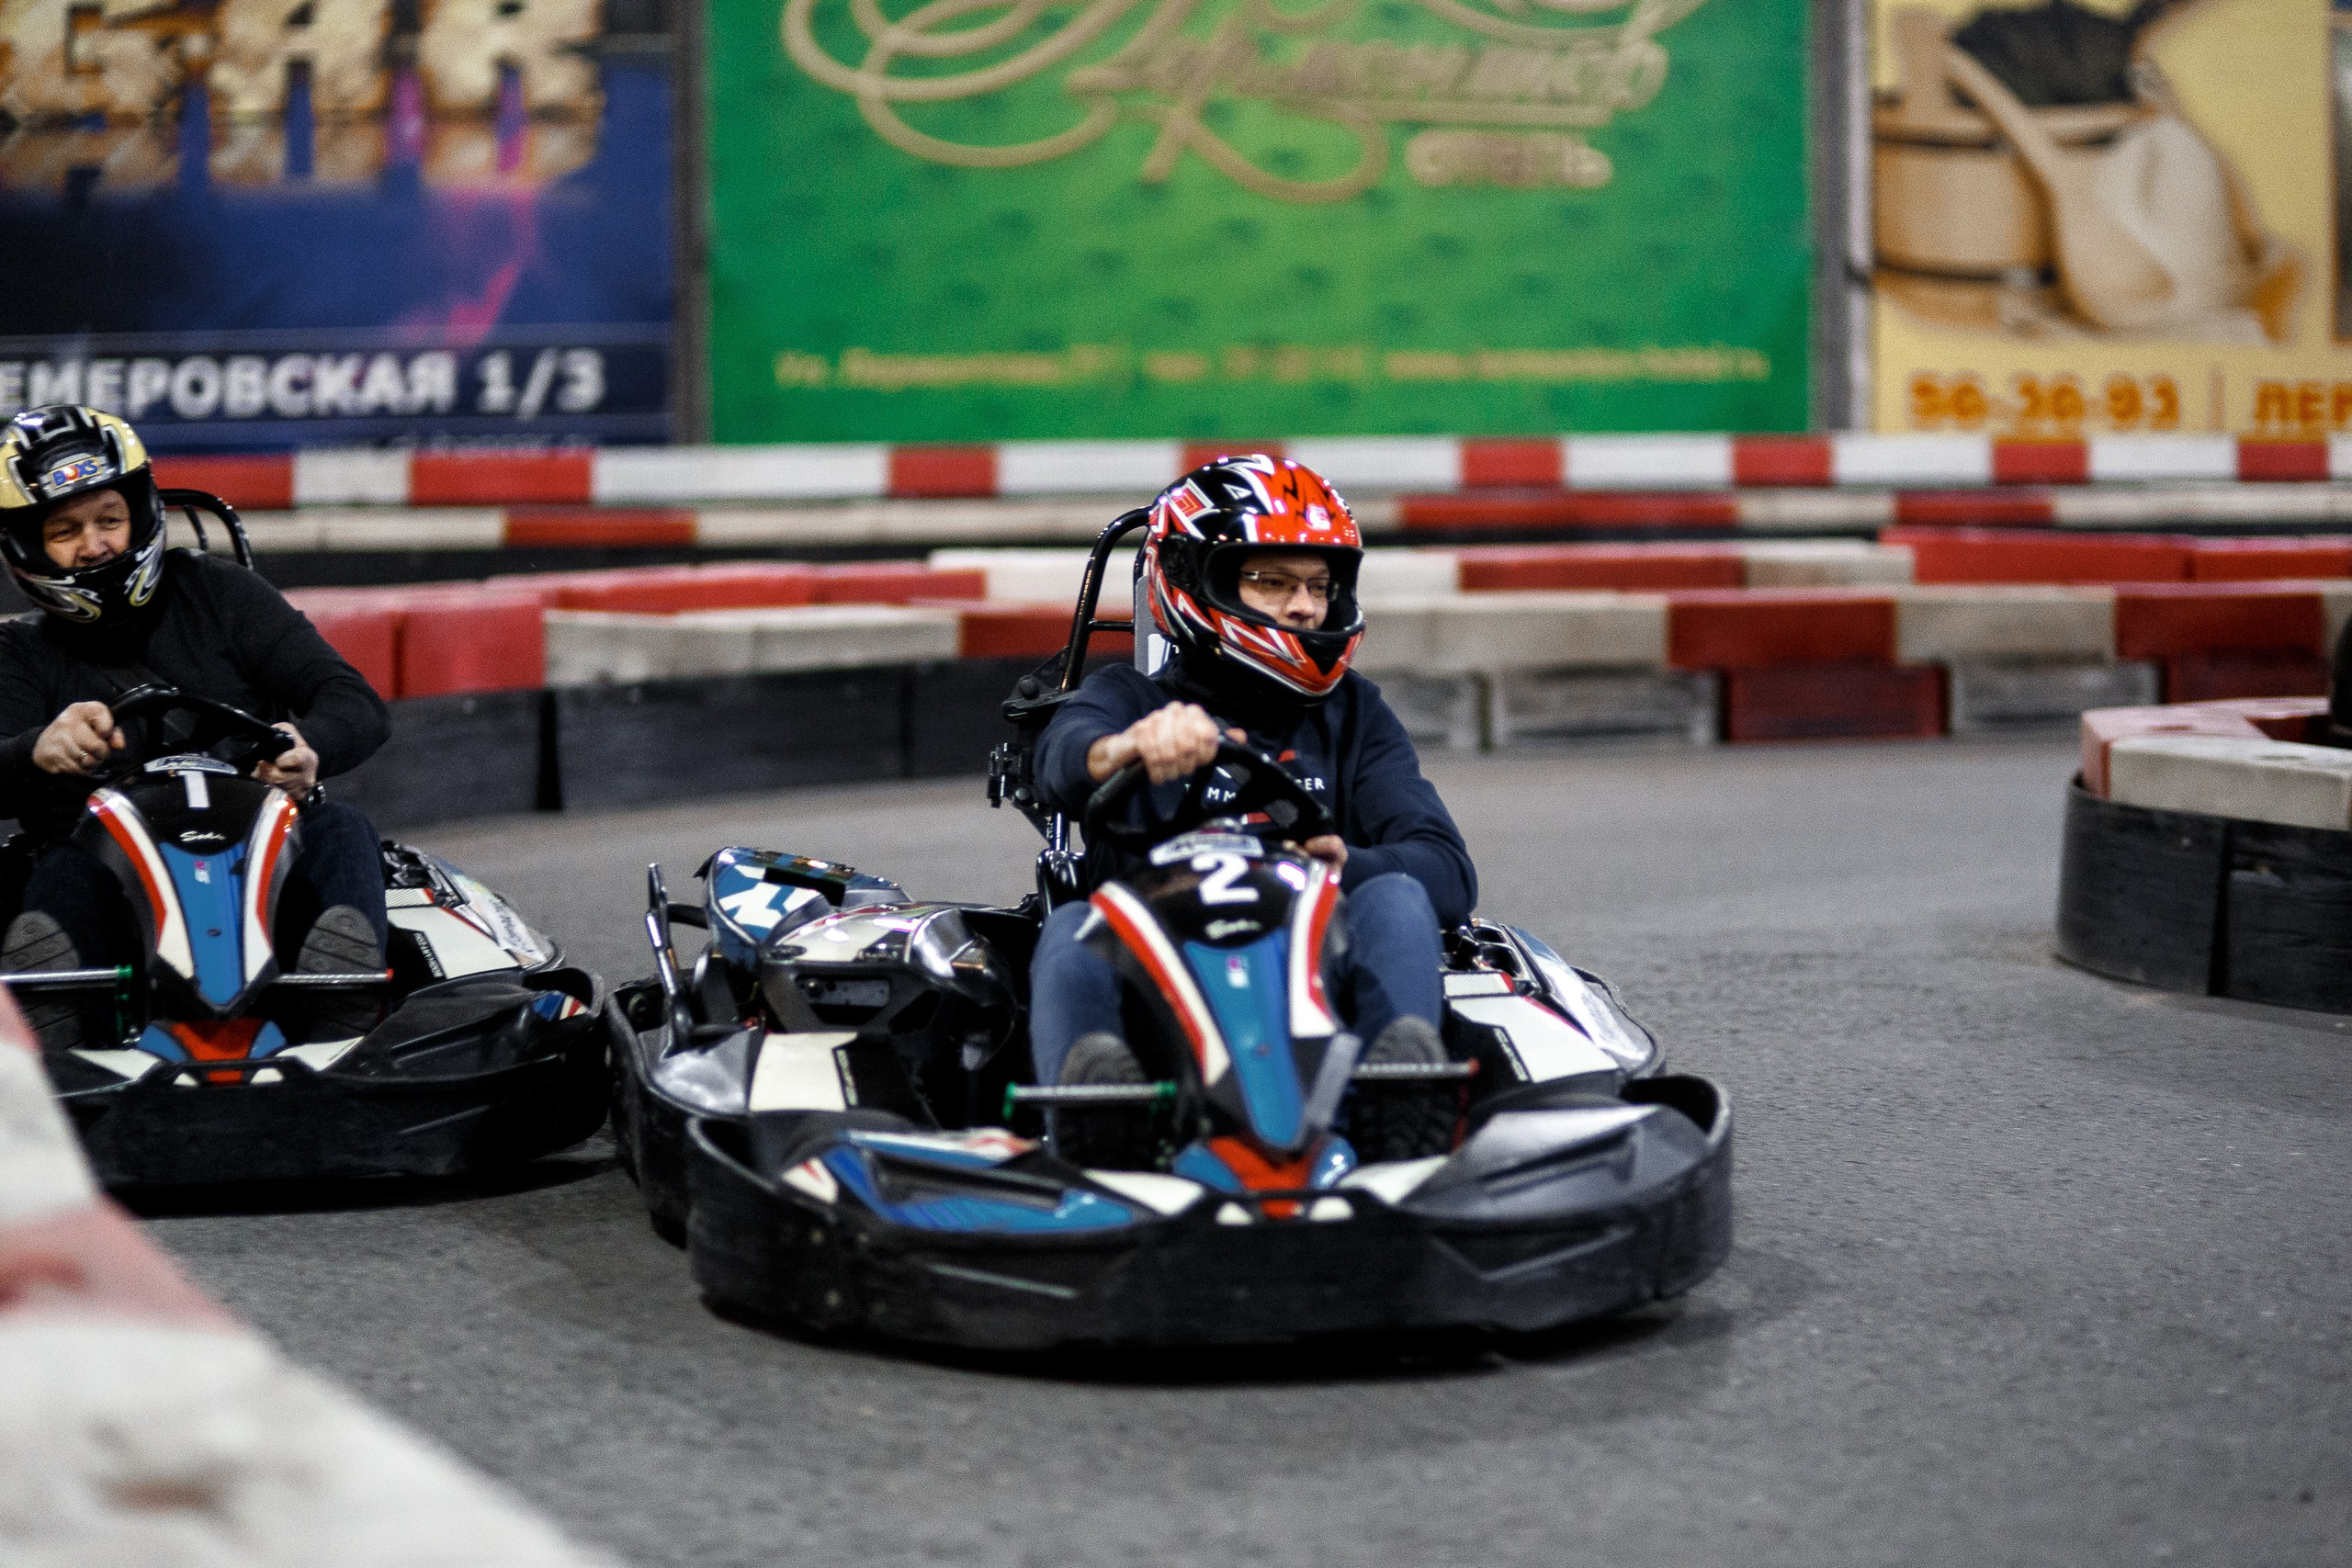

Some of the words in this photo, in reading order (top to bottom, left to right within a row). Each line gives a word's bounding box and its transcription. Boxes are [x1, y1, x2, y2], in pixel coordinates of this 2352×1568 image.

[475, 349, 605, 423] 1/3
[176, 770, 210, 808] 1
[1192, 852, 1260, 905] 2
